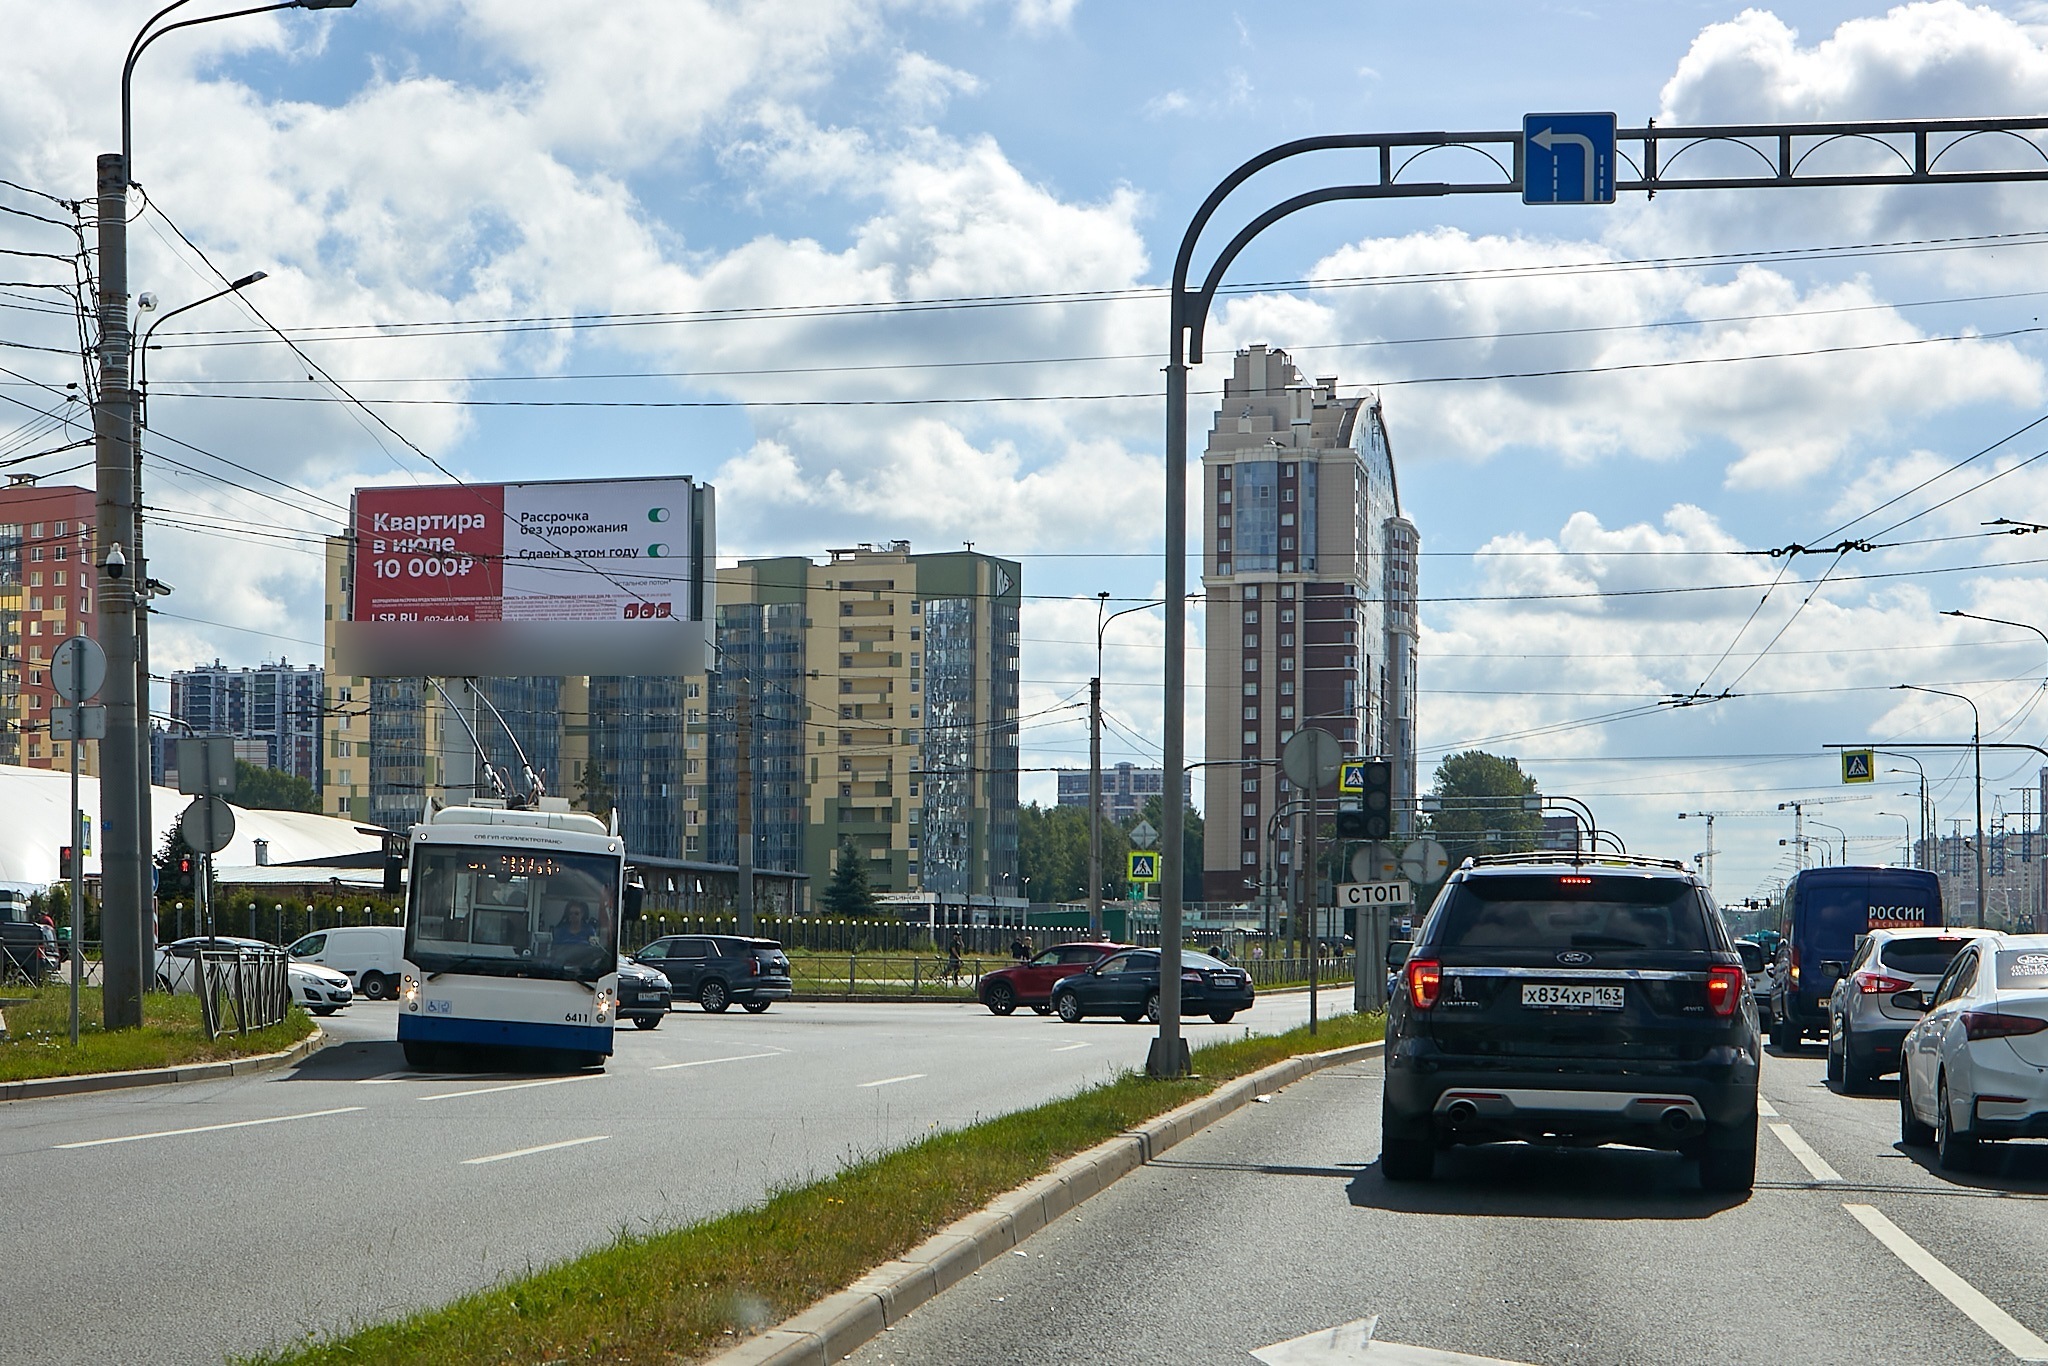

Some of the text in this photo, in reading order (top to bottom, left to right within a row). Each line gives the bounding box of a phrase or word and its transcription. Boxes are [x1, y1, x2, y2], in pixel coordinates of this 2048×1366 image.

[374, 513, 485, 535] Квартира
[521, 512, 589, 524] Рассрочка
[520, 524, 628, 537] без удорожания
[373, 537, 456, 554] в июле
[519, 549, 560, 560] Сдаем
[575, 550, 605, 558] этом
[609, 548, 639, 559] году
[373, 559, 401, 578] 10
[1348, 885, 1401, 904] СТОП
[1869, 906, 1925, 920] РОССИИ
[1527, 987, 1620, 1003] Х834ХР 163
[565, 1013, 588, 1023] 6411
